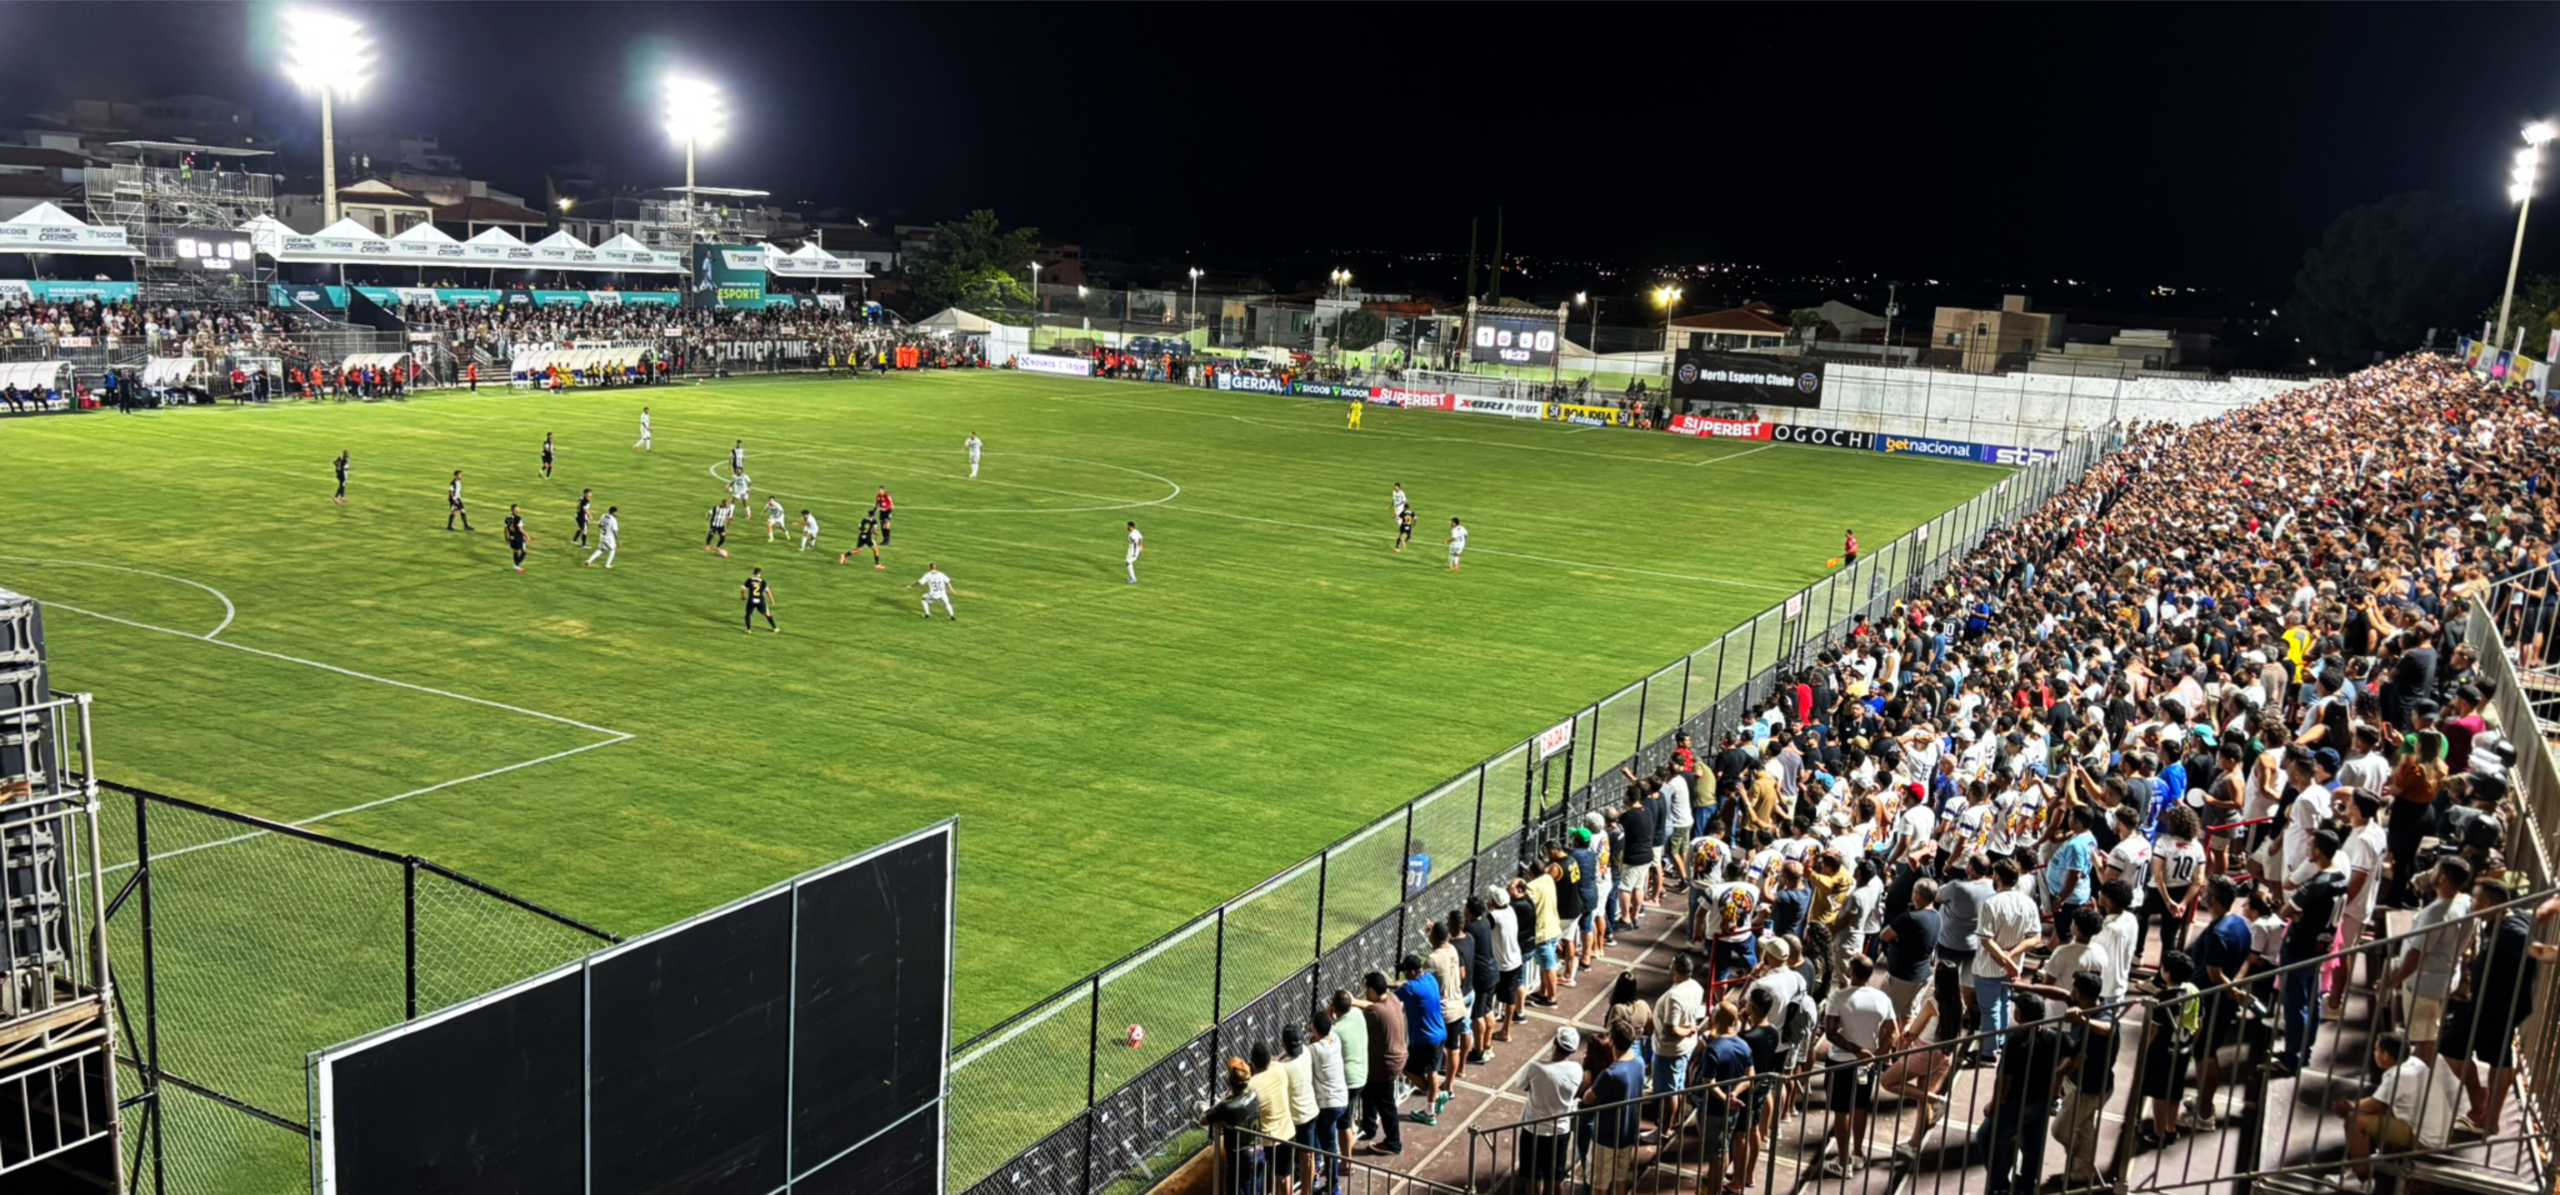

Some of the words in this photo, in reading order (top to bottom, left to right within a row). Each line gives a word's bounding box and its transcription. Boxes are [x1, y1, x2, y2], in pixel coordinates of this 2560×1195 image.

[95, 231, 123, 239] SICOOB
[738, 255, 757, 263] SICOOB
[718, 288, 761, 300] ESPORTE
[1540, 335, 1549, 349] 0
[720, 340, 774, 360] TLÉTICO
[1232, 375, 1283, 391] GERDAU
[1700, 369, 1727, 381] North
[1728, 371, 1765, 385] Esporte
[1765, 374, 1795, 387] Clube
[1302, 385, 1331, 395] SICOOB
[1340, 389, 1369, 398] SICOOB
[1379, 387, 1447, 407] SUPERBET
[1505, 403, 1539, 415] PNEUS
[1563, 406, 1586, 418] BOA
[1588, 408, 1613, 421] IDEIA
[1682, 416, 1763, 437] SUPERBET
[1774, 424, 1874, 450] OGOCHI
[1885, 436, 1970, 458] betnacional
[1996, 446, 2048, 468] sta
[752, 582, 761, 597] 2
[931, 580, 944, 592] 30
[1943, 621, 1956, 637] 10
[2171, 856, 2194, 881] 10
